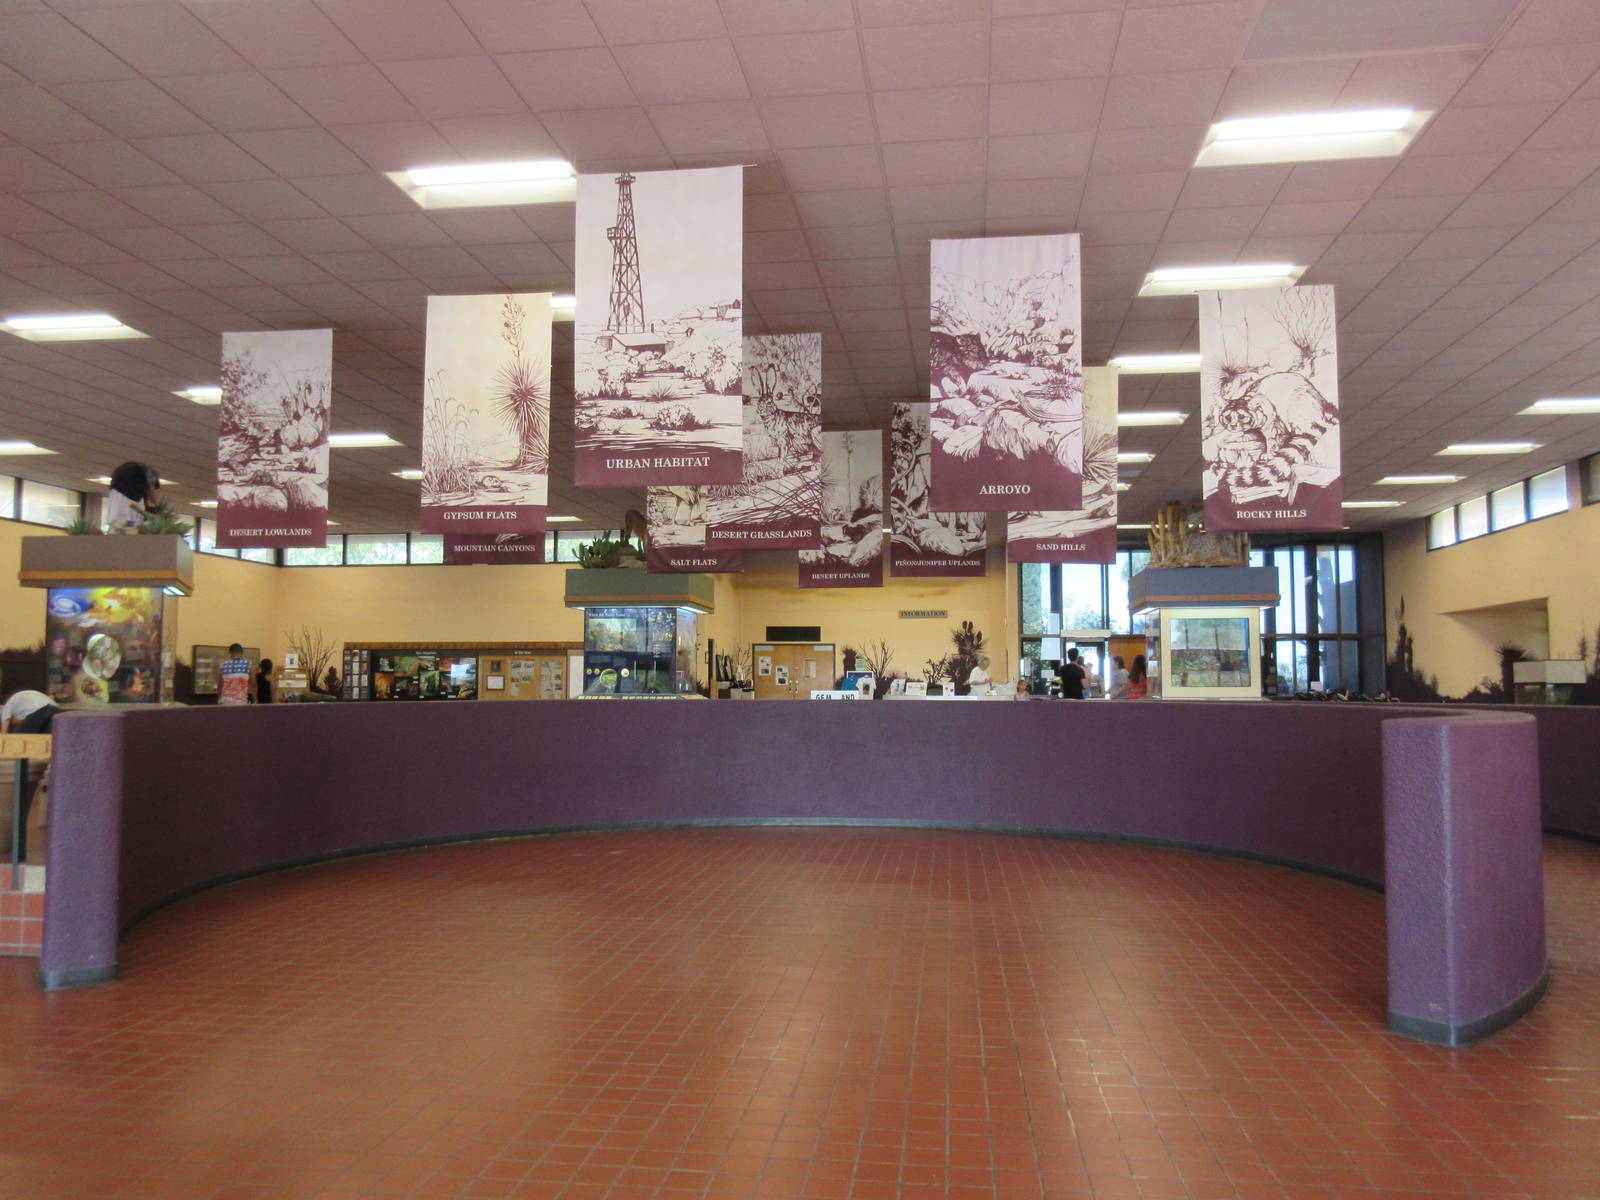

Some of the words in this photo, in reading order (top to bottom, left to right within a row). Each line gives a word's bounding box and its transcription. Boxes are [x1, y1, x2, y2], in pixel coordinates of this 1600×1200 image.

[606, 458, 651, 469] URBAN
[655, 456, 711, 468] HABITAT
[979, 484, 1031, 495] ARROYO
[443, 511, 484, 521] GYPSUM
[486, 510, 517, 520] FLATS
[1236, 510, 1273, 519] ROCKY
[1275, 509, 1307, 518] HILLS
[229, 529, 264, 537] DESERT
[265, 528, 313, 536] LOWLANDS
[711, 530, 749, 539] DESERT
[750, 528, 813, 538] GRASSLANDS
[453, 544, 496, 552] MOUNTAIN
[1035, 543, 1059, 551] SAND
[670, 558, 692, 566] SALT
[692, 558, 718, 566] FLATS
[948, 559, 981, 567] UPLANDS
